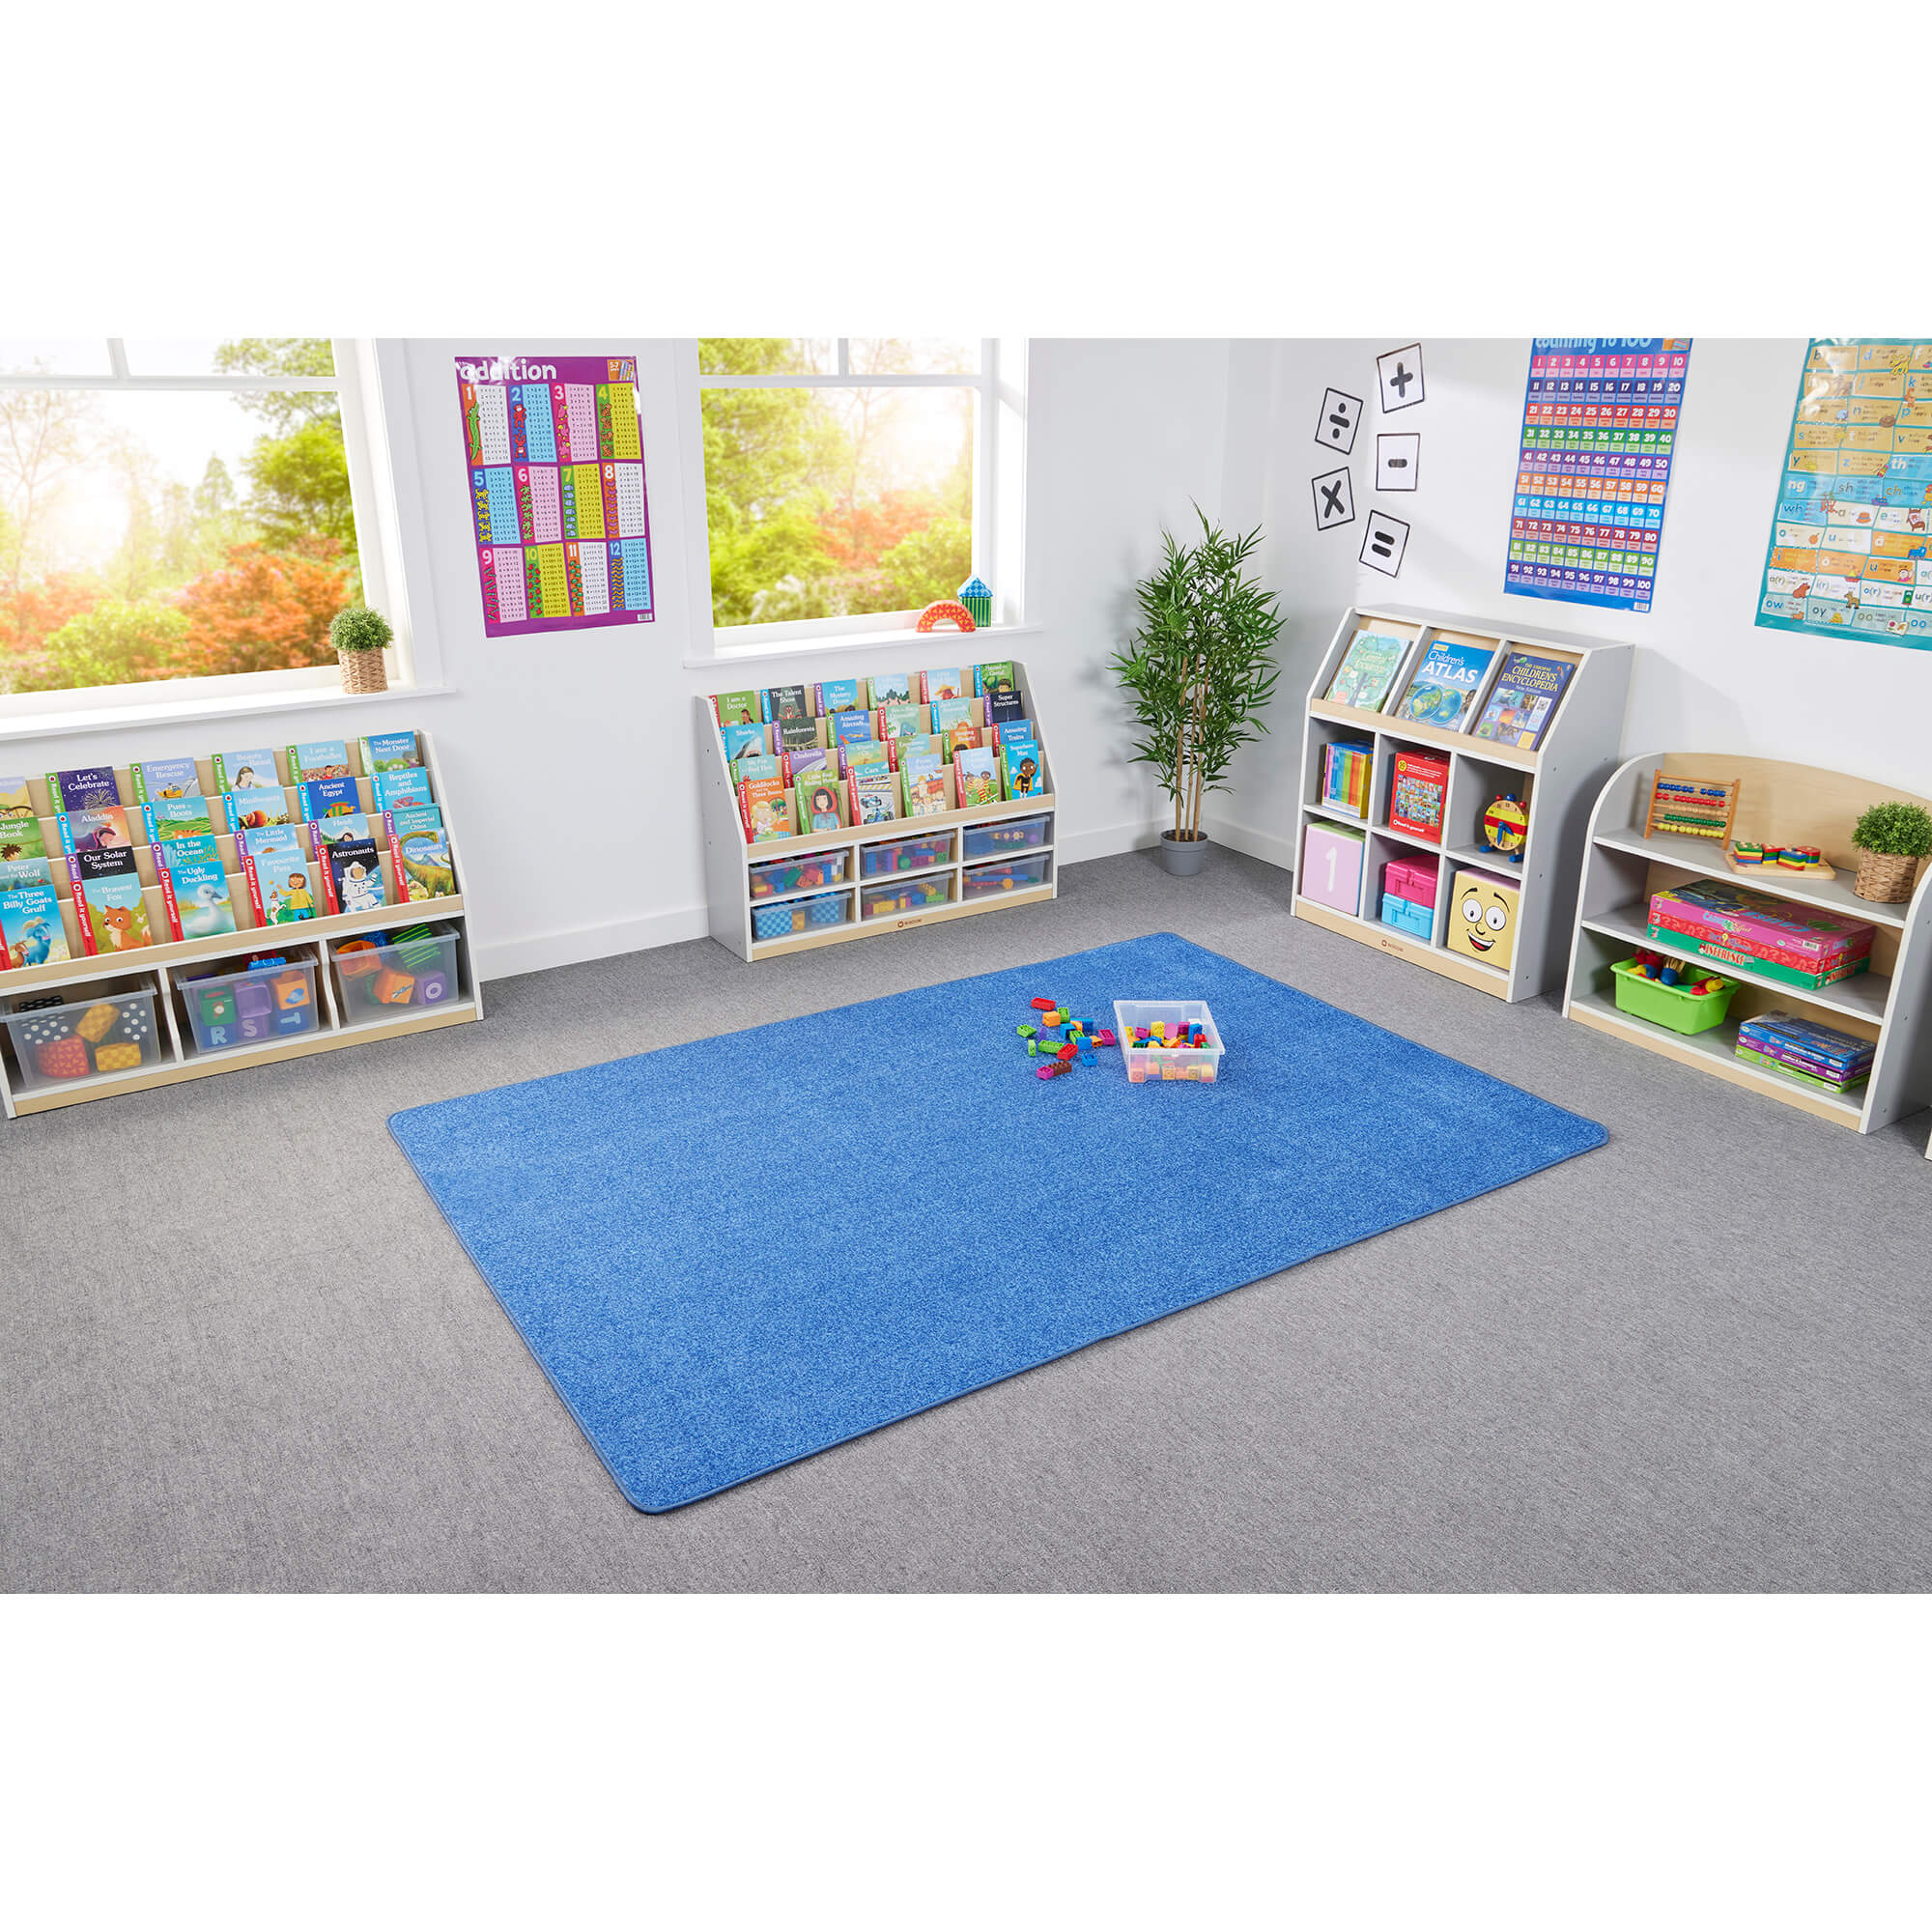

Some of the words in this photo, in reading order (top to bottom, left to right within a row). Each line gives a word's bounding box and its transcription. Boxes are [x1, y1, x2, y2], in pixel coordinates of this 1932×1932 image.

[1537, 357, 1542, 366] 1
[1549, 357, 1557, 366] 2
[1564, 357, 1571, 366] 3
[1594, 356, 1601, 366] 5
[1609, 357, 1616, 366] 6
[1626, 356, 1633, 365] 7
[1641, 356, 1649, 366] 8
[1659, 356, 1665, 365] 9
[1673, 356, 1684, 366] 10
[511, 386, 522, 402] 2
[554, 384, 565, 401] 3
[598, 384, 608, 400] 4
[1546, 382, 1555, 390] 12
[1560, 382, 1570, 390] 13
[1575, 382, 1584, 390] 14
[1589, 382, 1599, 391] 15
[1605, 382, 1614, 390] 16
[1636, 383, 1646, 391] 18
[1653, 382, 1662, 391] 19
[1667, 382, 1681, 391] 20
[1528, 405, 1538, 413] 21
[1542, 405, 1553, 413] 22
[1556, 406, 1568, 414] 23
[1570, 406, 1582, 414] 24
[1585, 407, 1597, 415] 25
[1600, 407, 1612, 415] 26
[1616, 407, 1629, 415] 27
[1632, 408, 1644, 416] 28
[1647, 408, 1661, 416] 29
[1663, 408, 1677, 417] 30
[473, 470, 485, 487] 5
[518, 469, 528, 483] 6
[563, 468, 573, 483] 7
[604, 465, 614, 479] 8
[525, 548, 538, 562] 10
[568, 544, 578, 557] 11
[610, 542, 621, 557] 12
[482, 550, 493, 566] 9
[1522, 565, 1534, 574] 92
[1537, 567, 1548, 576] 93
[1564, 571, 1576, 580] 95
[1578, 572, 1590, 581] 96
[1593, 574, 1605, 582] 97
[1607, 576, 1620, 585] 98
[1622, 578, 1635, 586] 99
[1636, 579, 1652, 589] 100
[1429, 650, 1465, 667] Children's
[1421, 661, 1479, 684] ATLAS
[1512, 666, 1558, 683] CHILDREN'S
[1501, 672, 1559, 693] ENCYCLOPEDIA
[382, 738, 410, 747] Monster
[76, 772, 99, 782] Let's
[68, 780, 110, 792] Celebrate
[318, 781, 346, 791] Ancient
[323, 788, 344, 798] Egypt
[81, 812, 115, 823] Aladdin
[175, 841, 185, 850] In
[186, 839, 202, 849] the
[83, 853, 101, 863] Our
[102, 850, 128, 860] Solar
[176, 847, 204, 858] Ocean
[331, 845, 376, 859] Astronauts
[90, 859, 124, 871] System
[186, 866, 206, 876] Ugly
[1324, 845, 1339, 894] 1
[181, 872, 218, 885] Duckling
[17, 890, 45, 900] Three
[2, 899, 24, 911] Billy
[25, 895, 53, 906] Goats
[21, 904, 47, 915] Gruff
[242, 1019, 258, 1037] S
[210, 1026, 228, 1045] R
